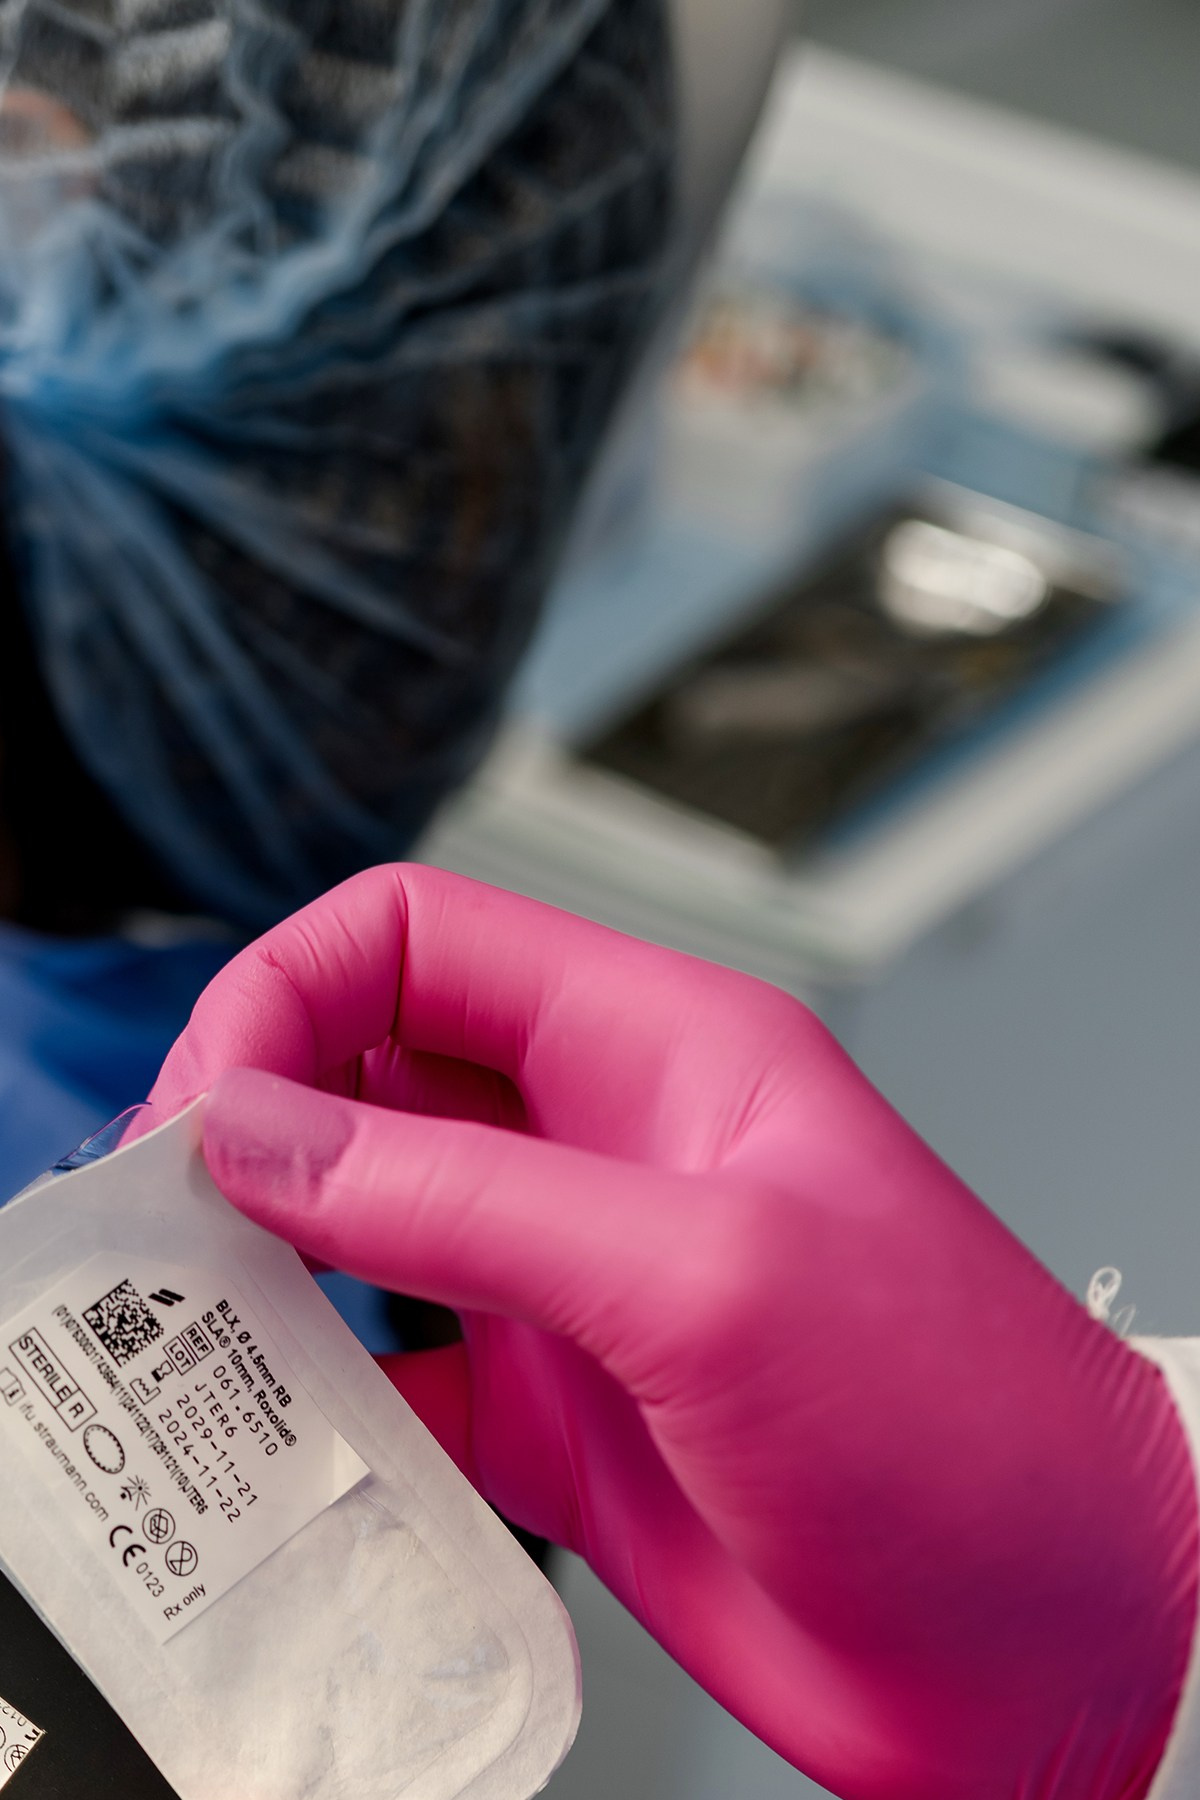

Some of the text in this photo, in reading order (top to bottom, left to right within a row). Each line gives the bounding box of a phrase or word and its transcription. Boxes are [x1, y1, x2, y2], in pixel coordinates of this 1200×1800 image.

[18, 1336, 85, 1419] STERILE R
[169, 1342, 237, 1438] LOT JTER6
[186, 1327, 278, 1457] REF 061.6510
[202, 1311, 297, 1447] SLA® 10mm, Roxolid®
[215, 1299, 292, 1408] BLX, Ø 4.5mm RB
[19, 1400, 110, 1522] ifu.straumann.com
[158, 1408, 241, 1523] 2024-11-22
[176, 1393, 258, 1506] 2029-11-21
[135, 1561, 165, 1598] 0123
[163, 1583, 207, 1621] Rx only
